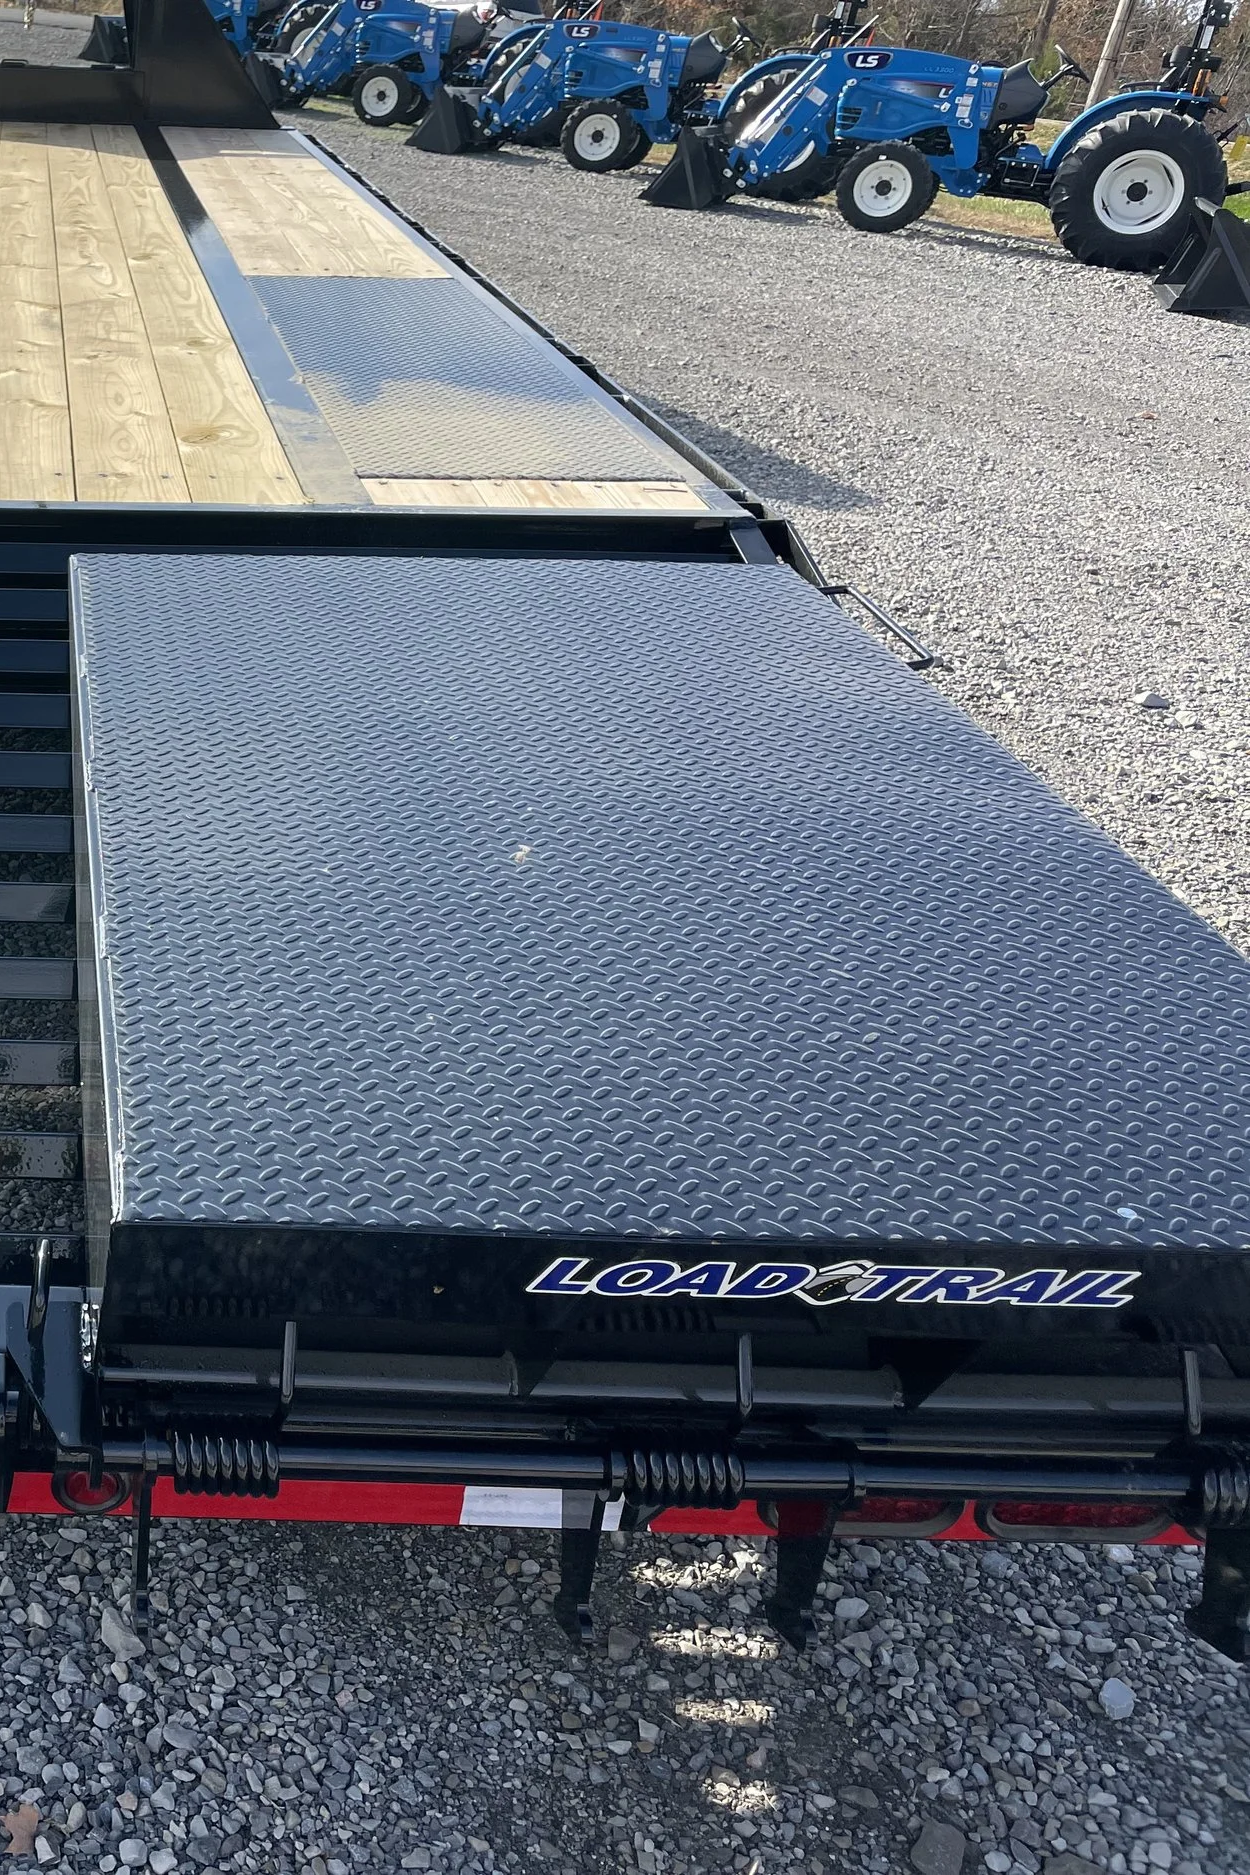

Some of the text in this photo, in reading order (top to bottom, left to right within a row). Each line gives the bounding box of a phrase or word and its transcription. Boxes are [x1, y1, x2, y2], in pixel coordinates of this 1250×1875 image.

[360, 0, 376, 10] LS
[571, 26, 590, 37] LS
[855, 55, 879, 67] LS
[525, 1256, 1143, 1307] LOAD TRAIL
